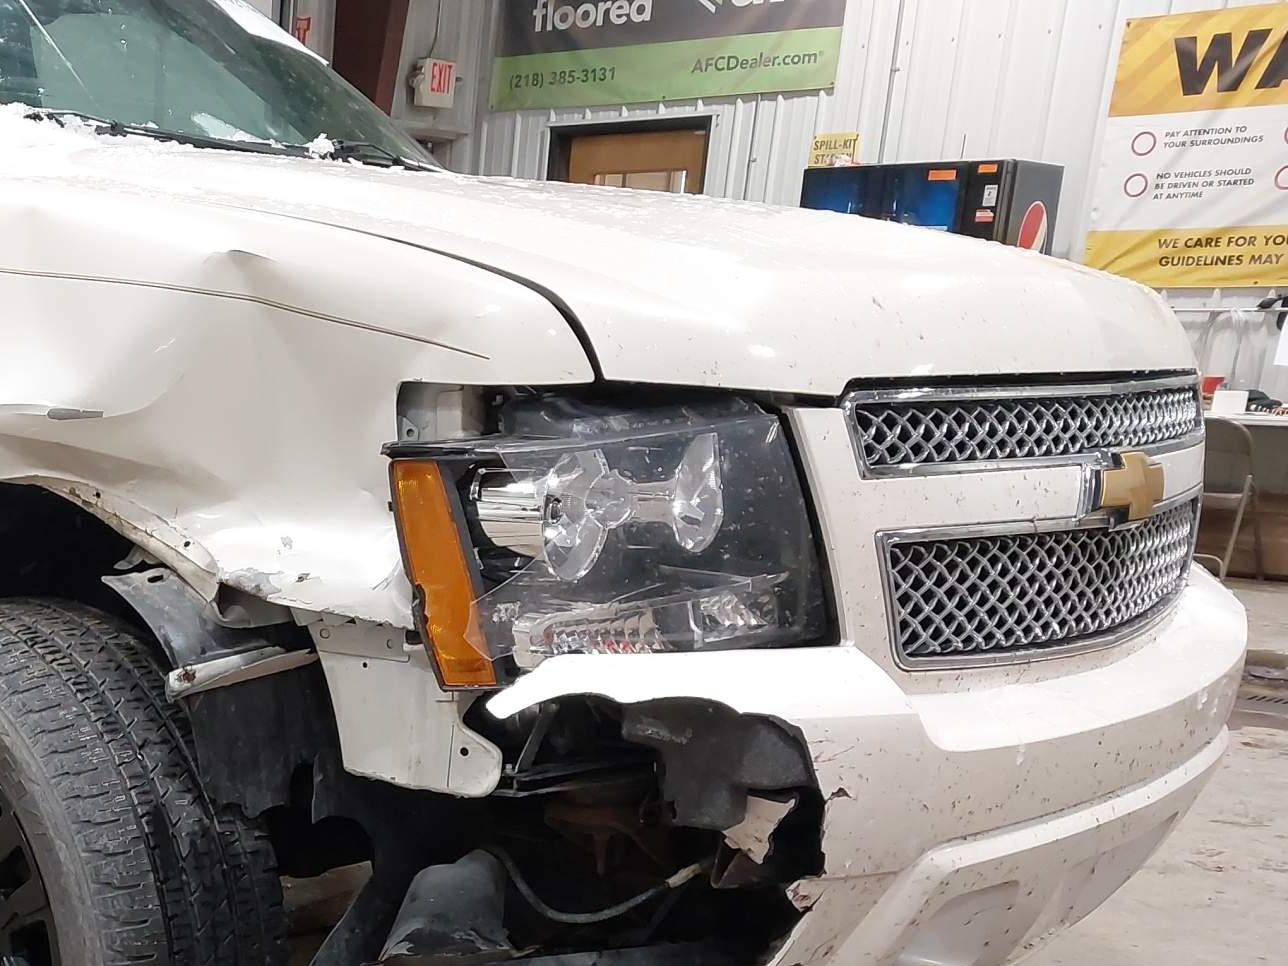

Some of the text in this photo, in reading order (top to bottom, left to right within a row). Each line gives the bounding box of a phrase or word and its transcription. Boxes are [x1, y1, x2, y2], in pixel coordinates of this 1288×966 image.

[532, 0, 652, 32] floored
[430, 62, 454, 94] EXIT
[509, 66, 616, 90] (218) 385-3131
[1182, 127, 1232, 137] ATTENTION
[1235, 125, 1248, 133] TO
[813, 139, 857, 151] SPILL-KIT
[1163, 135, 1264, 149] YOUR SURROUNDINGS
[1156, 167, 1252, 180] NO VEHICLES SHOULD
[1154, 178, 1255, 190] BE DRIVEN OR STARTED
[1153, 191, 1203, 200] AT ANYTIME
[1158, 234, 1288, 249] WE CARE FOR YO
[1158, 253, 1284, 267] GUIDELINES MAY
